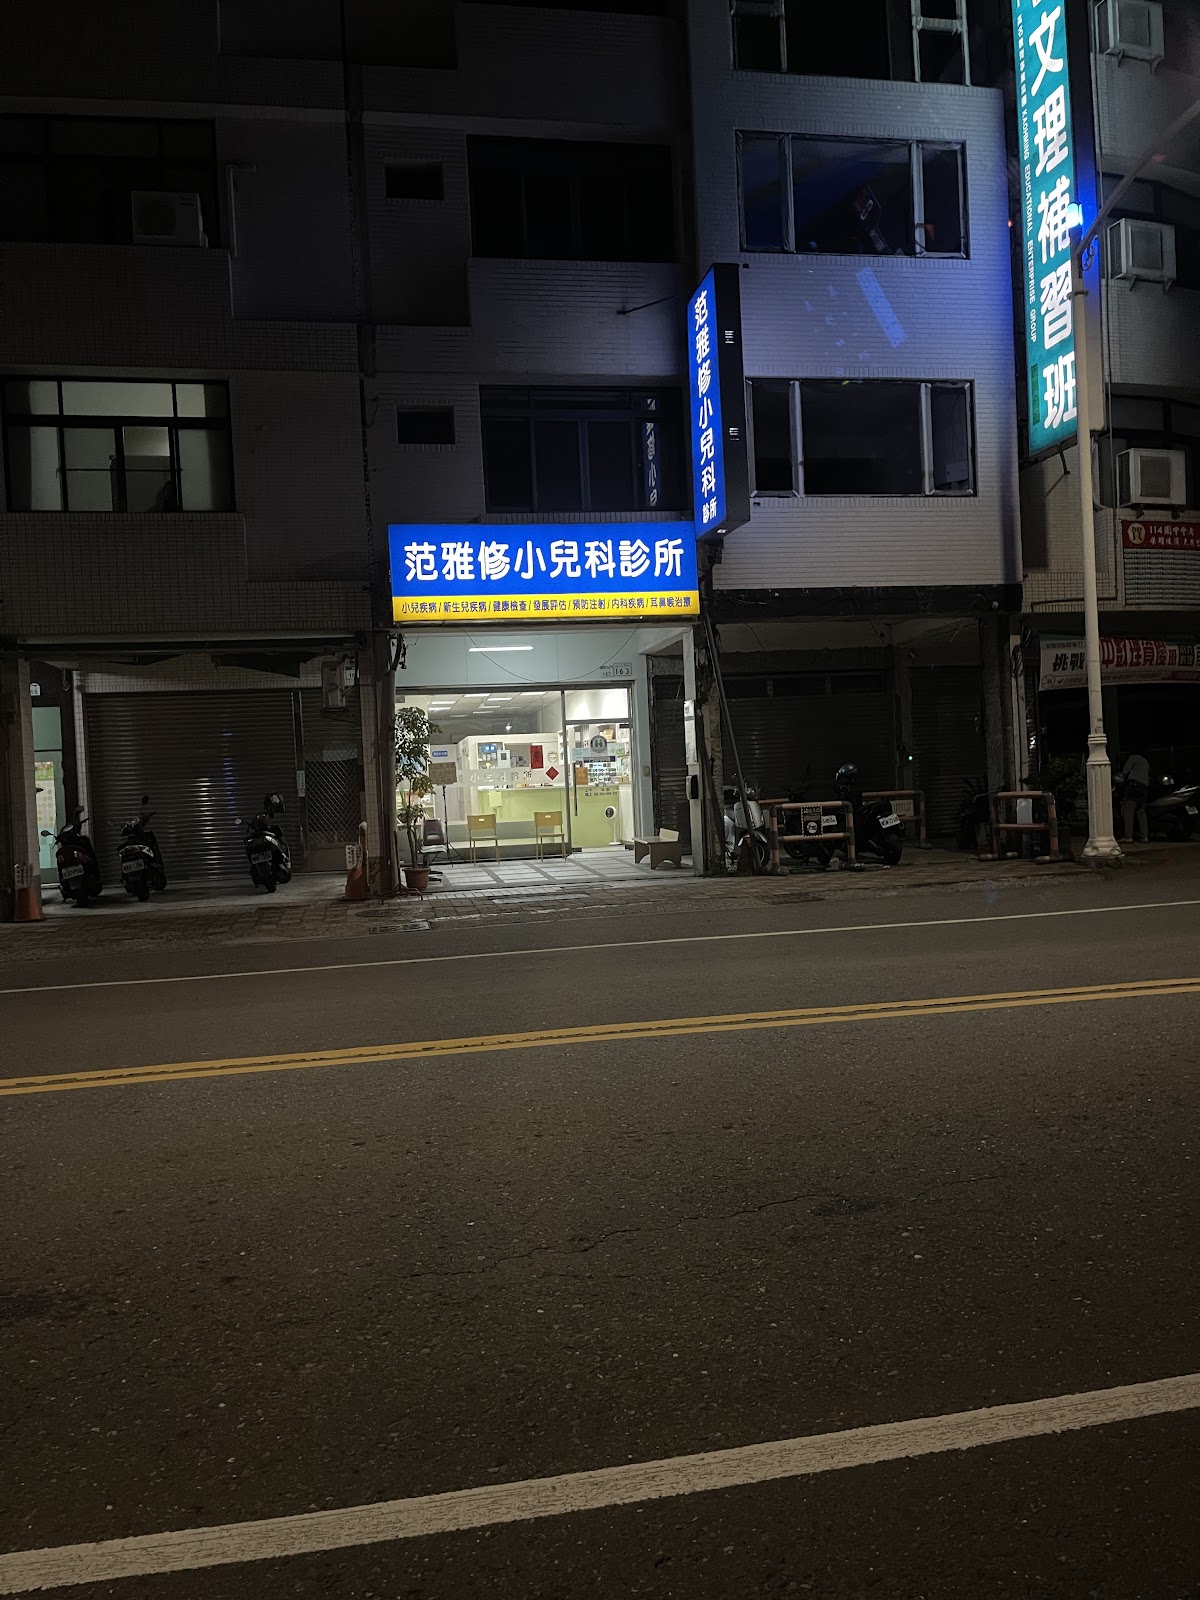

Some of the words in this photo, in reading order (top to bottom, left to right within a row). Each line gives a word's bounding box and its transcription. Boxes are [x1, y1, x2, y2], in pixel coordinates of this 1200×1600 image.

[1021, 108, 1030, 160] KAOHMING
[1024, 164, 1033, 236] EDUCATIONAL
[1029, 0, 1078, 430] 文理補習班
[1027, 240, 1036, 305] ENTERPRISE
[1029, 309, 1037, 343] GROUP
[404, 538, 684, 582] 范雅修小兒科診所
[615, 667, 630, 675] 163
